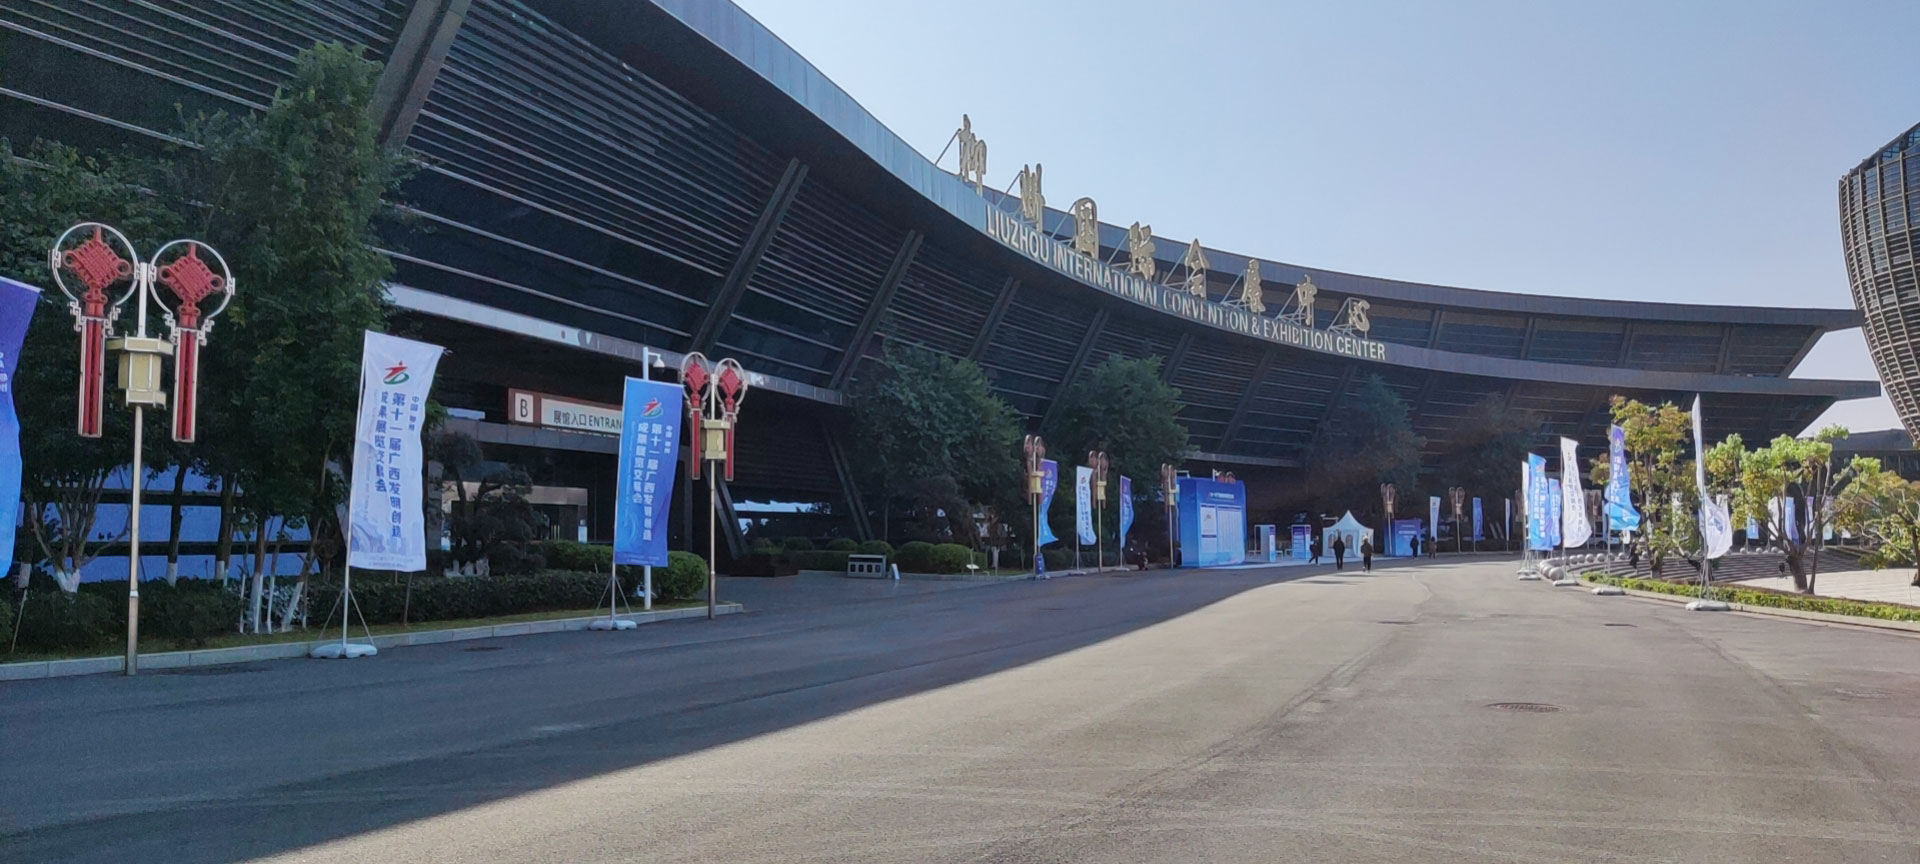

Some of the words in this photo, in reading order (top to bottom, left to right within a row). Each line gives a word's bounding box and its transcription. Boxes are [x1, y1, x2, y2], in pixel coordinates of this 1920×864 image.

[986, 203, 1049, 262] LIUZHOU
[1053, 241, 1159, 307] INTERNATIONAL
[1163, 289, 1248, 333] CONVENTION
[1251, 317, 1260, 336] &
[1263, 319, 1333, 352] EXHIBITION
[1336, 335, 1385, 361] CENTER
[520, 398, 528, 418] B
[553, 410, 587, 426] 展馆入口
